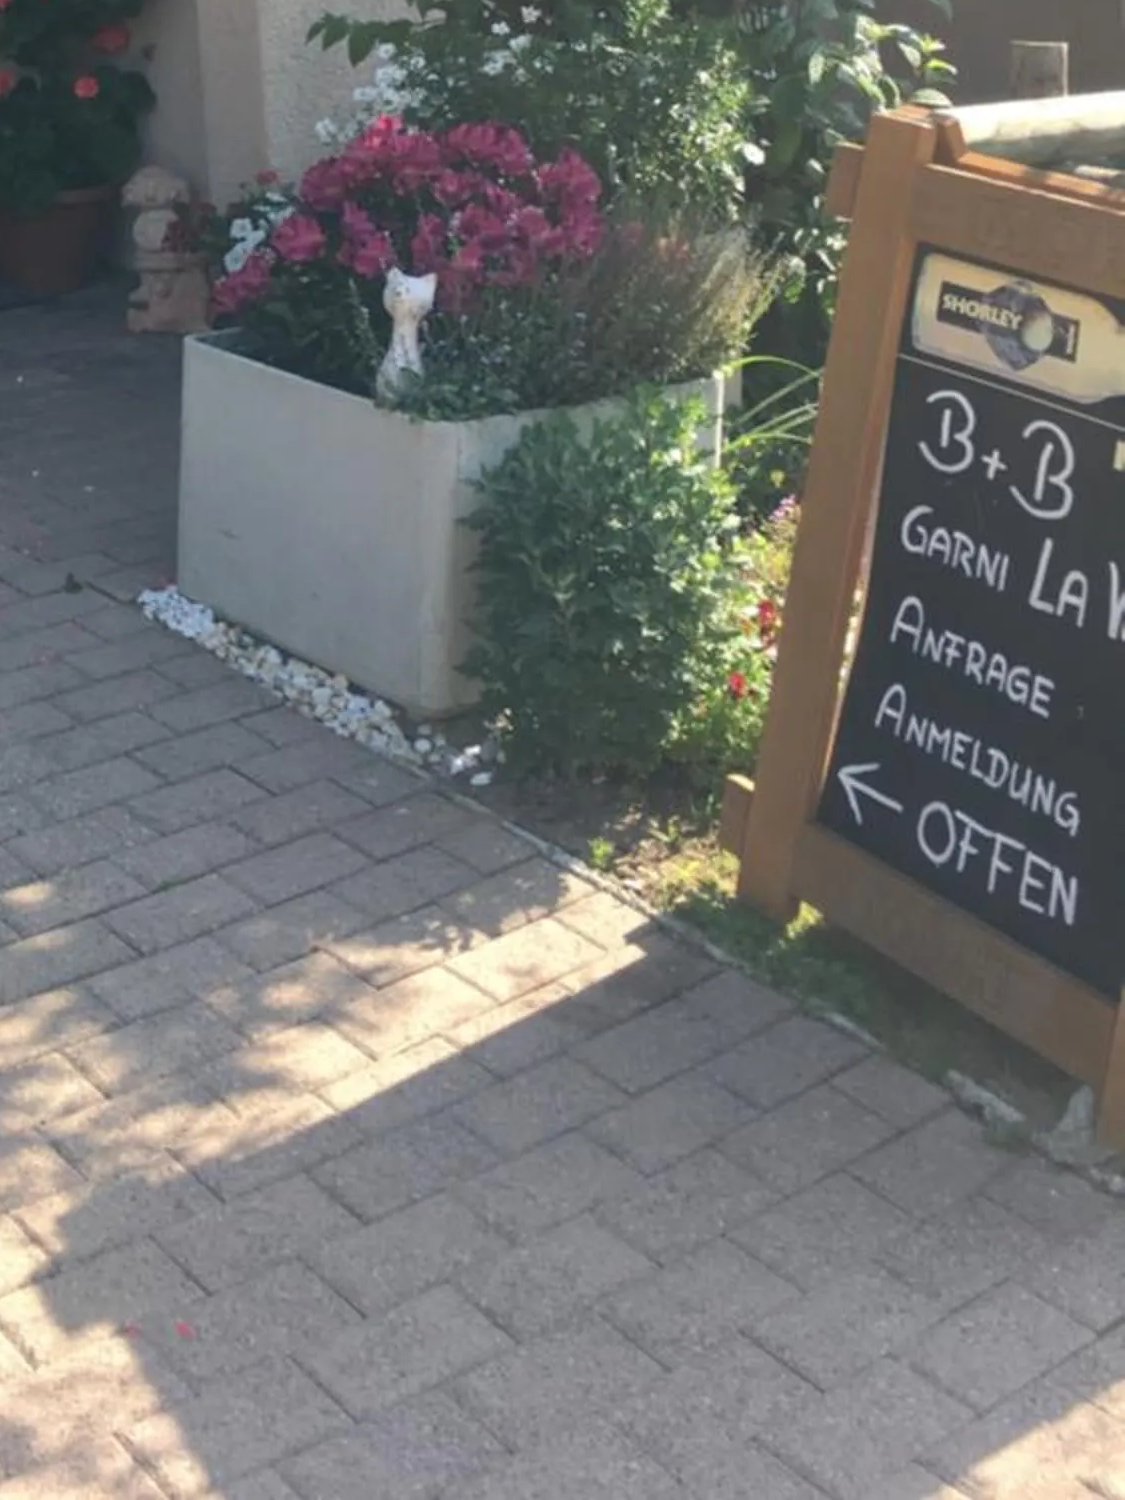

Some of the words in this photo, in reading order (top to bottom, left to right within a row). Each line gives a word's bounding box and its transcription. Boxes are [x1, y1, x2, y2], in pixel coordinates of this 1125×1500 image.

[941, 293, 1024, 331] SHORLEY
[901, 504, 1010, 592] GARNI
[1028, 537, 1089, 628] LA
[889, 595, 1056, 719] ANFRAGE
[874, 683, 1081, 837] ANMELDUNG
[917, 801, 1078, 926] OFFEN
